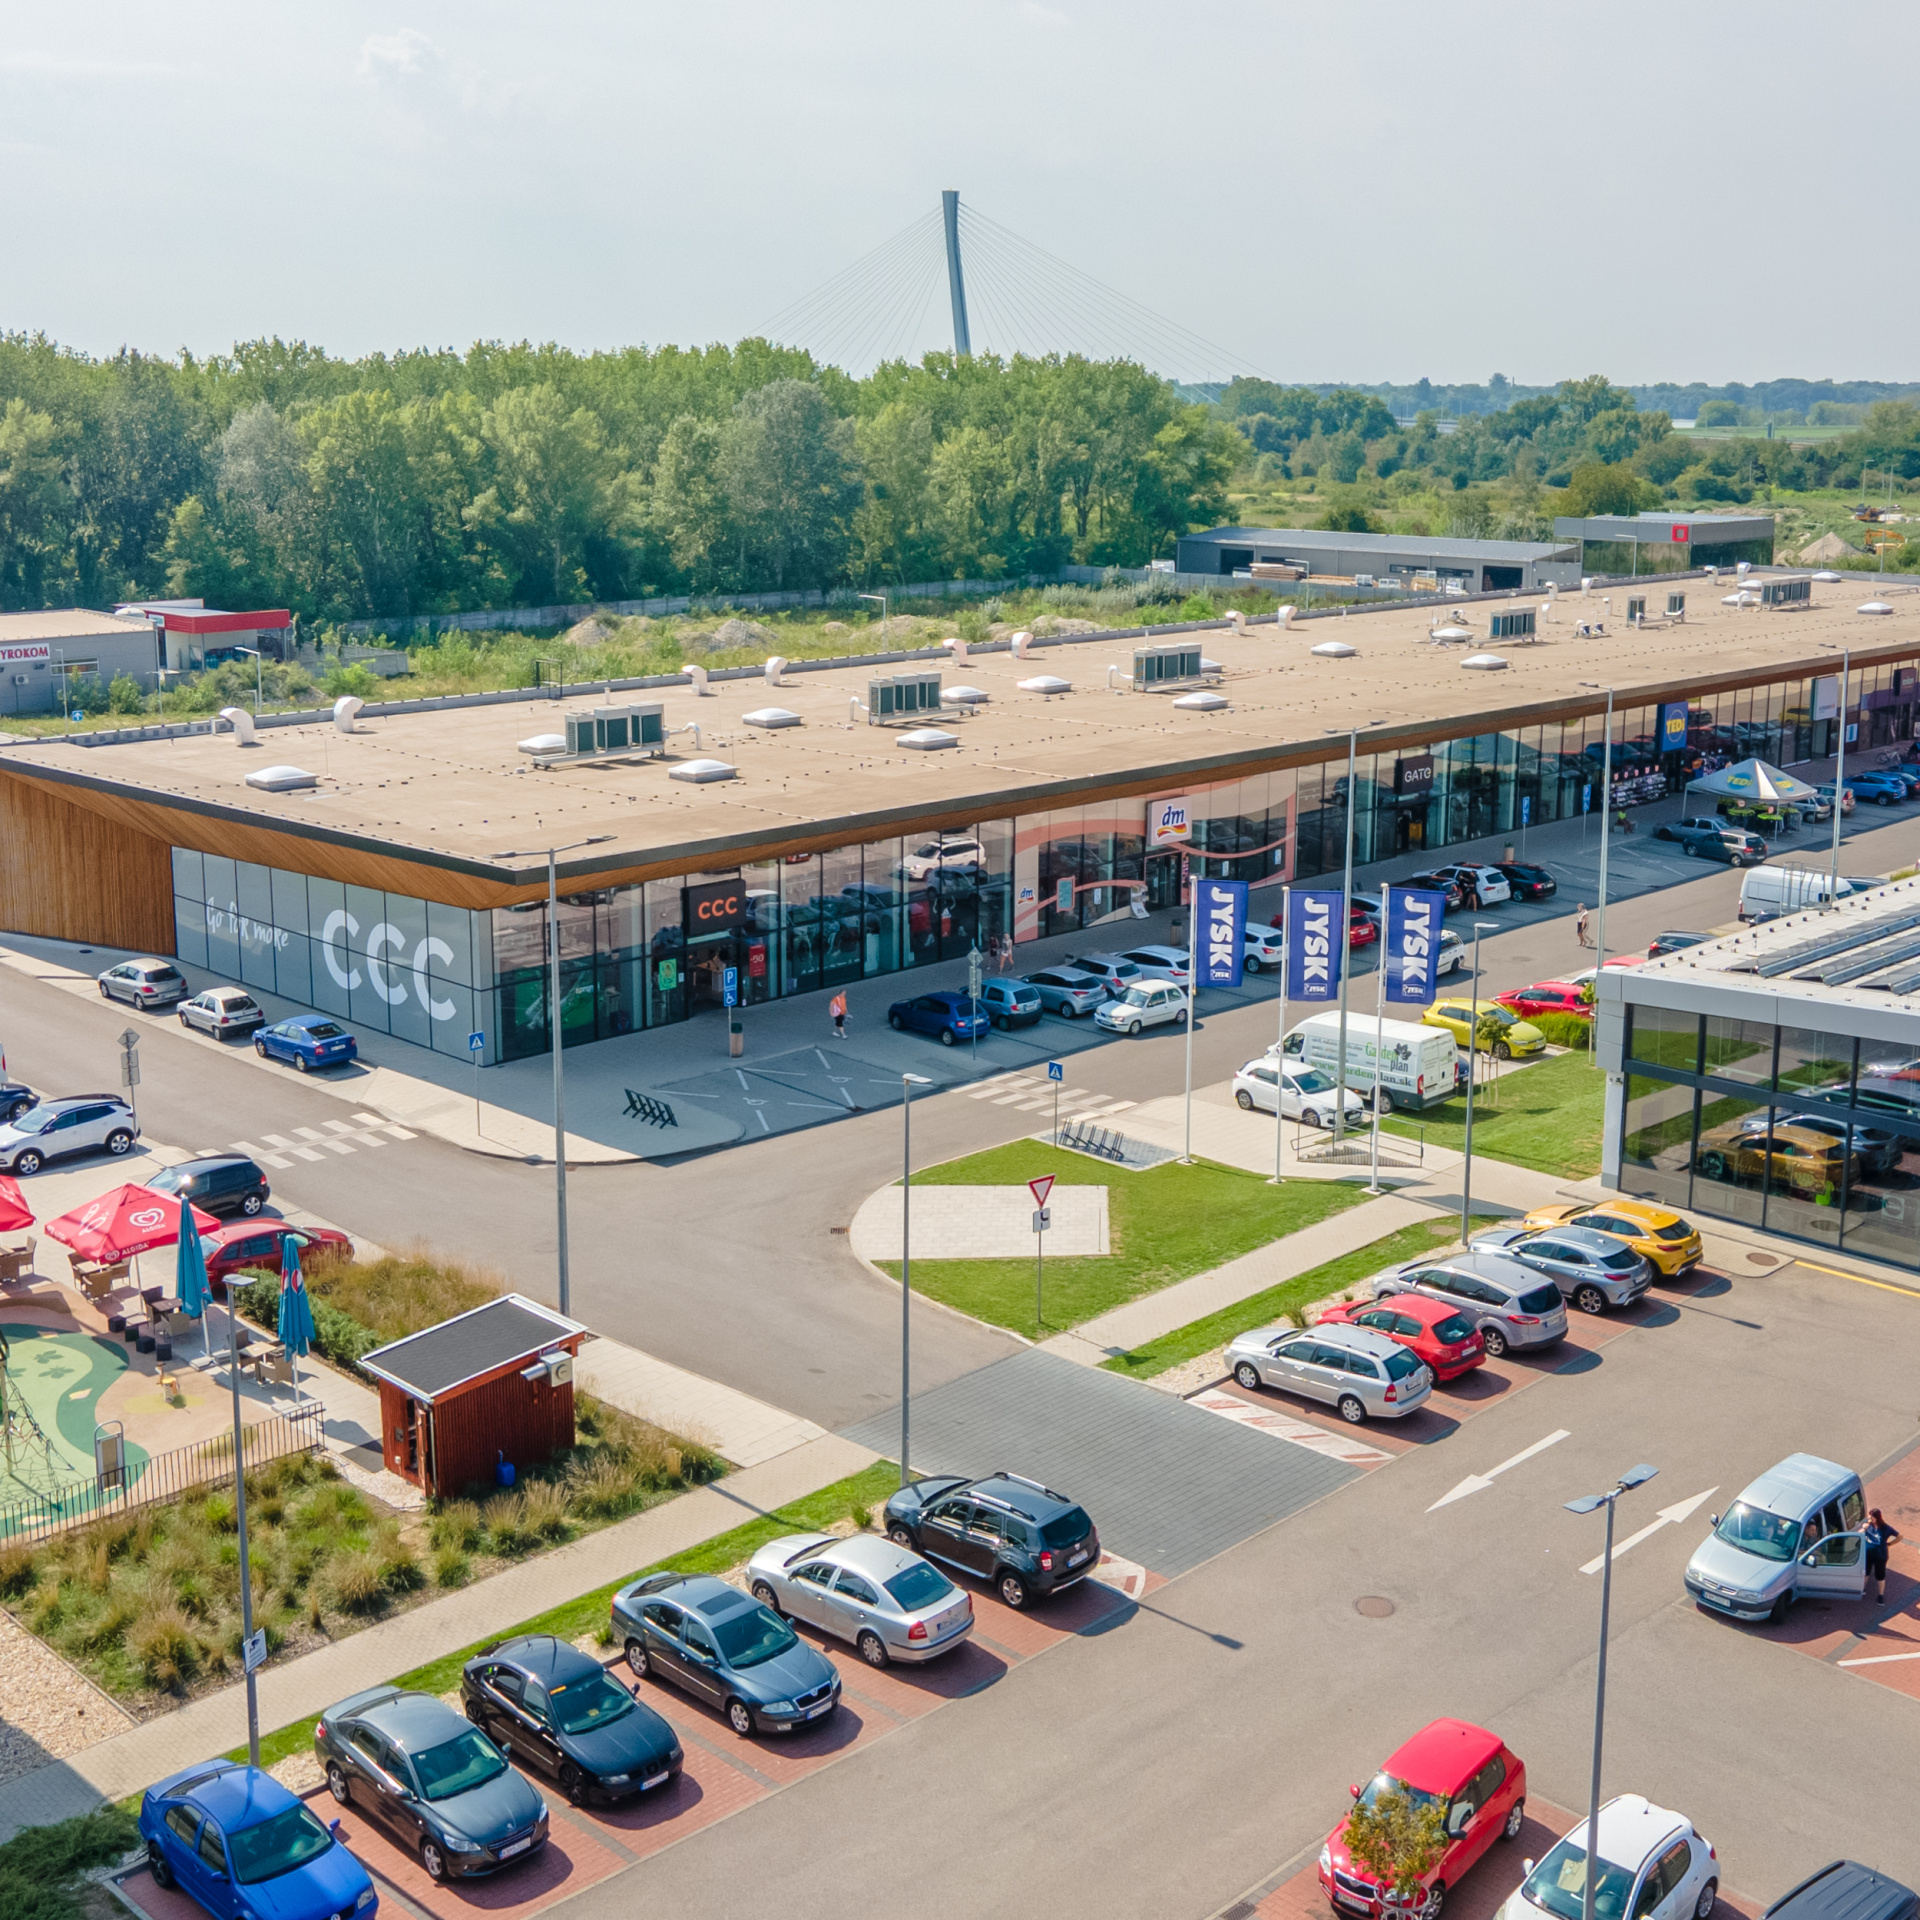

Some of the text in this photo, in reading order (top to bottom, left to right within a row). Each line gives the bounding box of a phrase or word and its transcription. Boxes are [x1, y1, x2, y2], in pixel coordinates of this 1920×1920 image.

[1162, 805, 1185, 826] dm
[206, 896, 225, 934] Go
[698, 896, 738, 919] CCC
[1209, 886, 1235, 968] JYSK
[1304, 897, 1330, 981] JYSK
[1402, 895, 1431, 983] JYSK
[322, 909, 457, 1021] CCC
[726, 971, 734, 984] P
[1365, 1042, 1399, 1062] Gaden
[1390, 1056, 1409, 1073] plan
